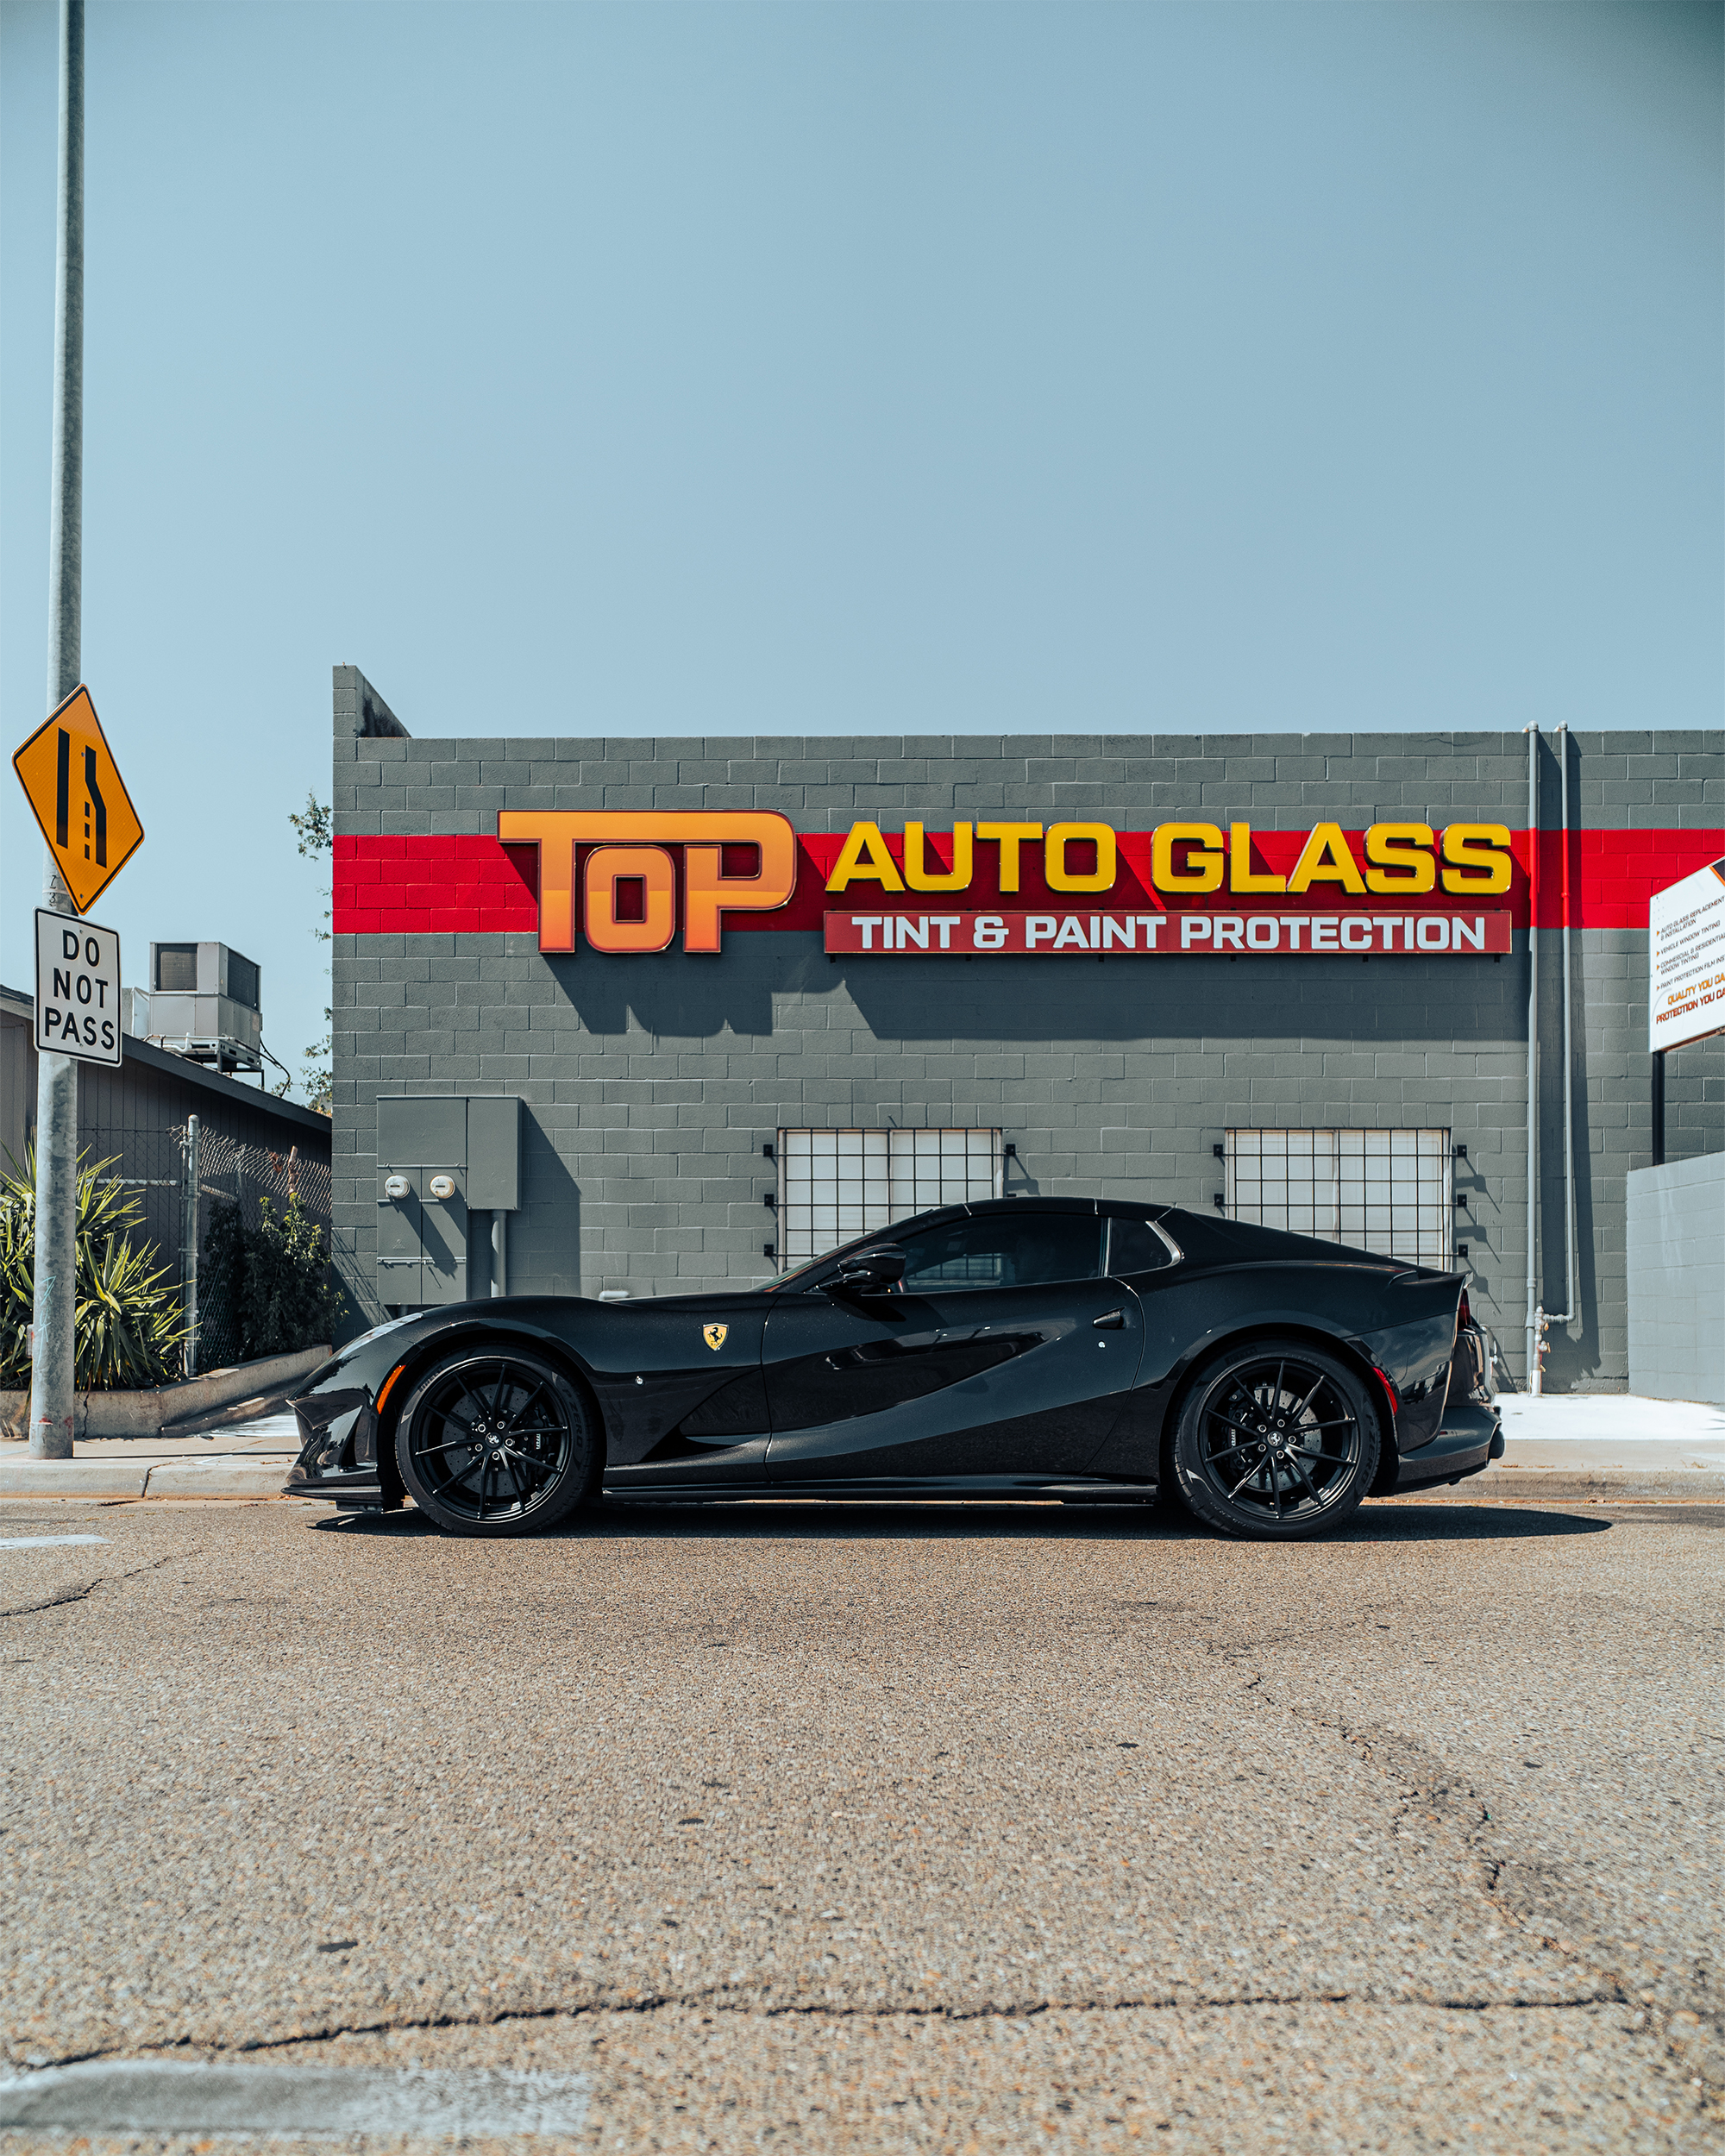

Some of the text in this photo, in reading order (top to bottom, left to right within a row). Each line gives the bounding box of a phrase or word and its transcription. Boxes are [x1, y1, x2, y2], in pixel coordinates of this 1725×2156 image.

[497, 809, 1512, 953] TOP AUTO GLASS
[1661, 895, 1725, 933] AUTO GLASS REPLACEMENT
[1665, 918, 1696, 938] INSTALLATION
[62, 929, 100, 968] DO
[851, 916, 1485, 950] TINT & PAINT PROTECTION
[1660, 919, 1721, 955] VEHICLE WINDOW TINTING
[1660, 950, 1689, 968] COMMERCIAL
[1660, 952, 1699, 975] WINDOW TINTING
[1660, 954, 1725, 989] PAINT PROTECTION FILM INS
[53, 967, 109, 1009] NOT
[1668, 984, 1697, 1006] QUALITY
[1697, 977, 1713, 992] YOU
[1656, 999, 1698, 1025] PROTECTION
[1699, 992, 1715, 1006] YOU
[45, 1006, 115, 1050] PASS
[562, 1389, 583, 1448] P ZERO
[1362, 1414, 1377, 1484] P ZERO
